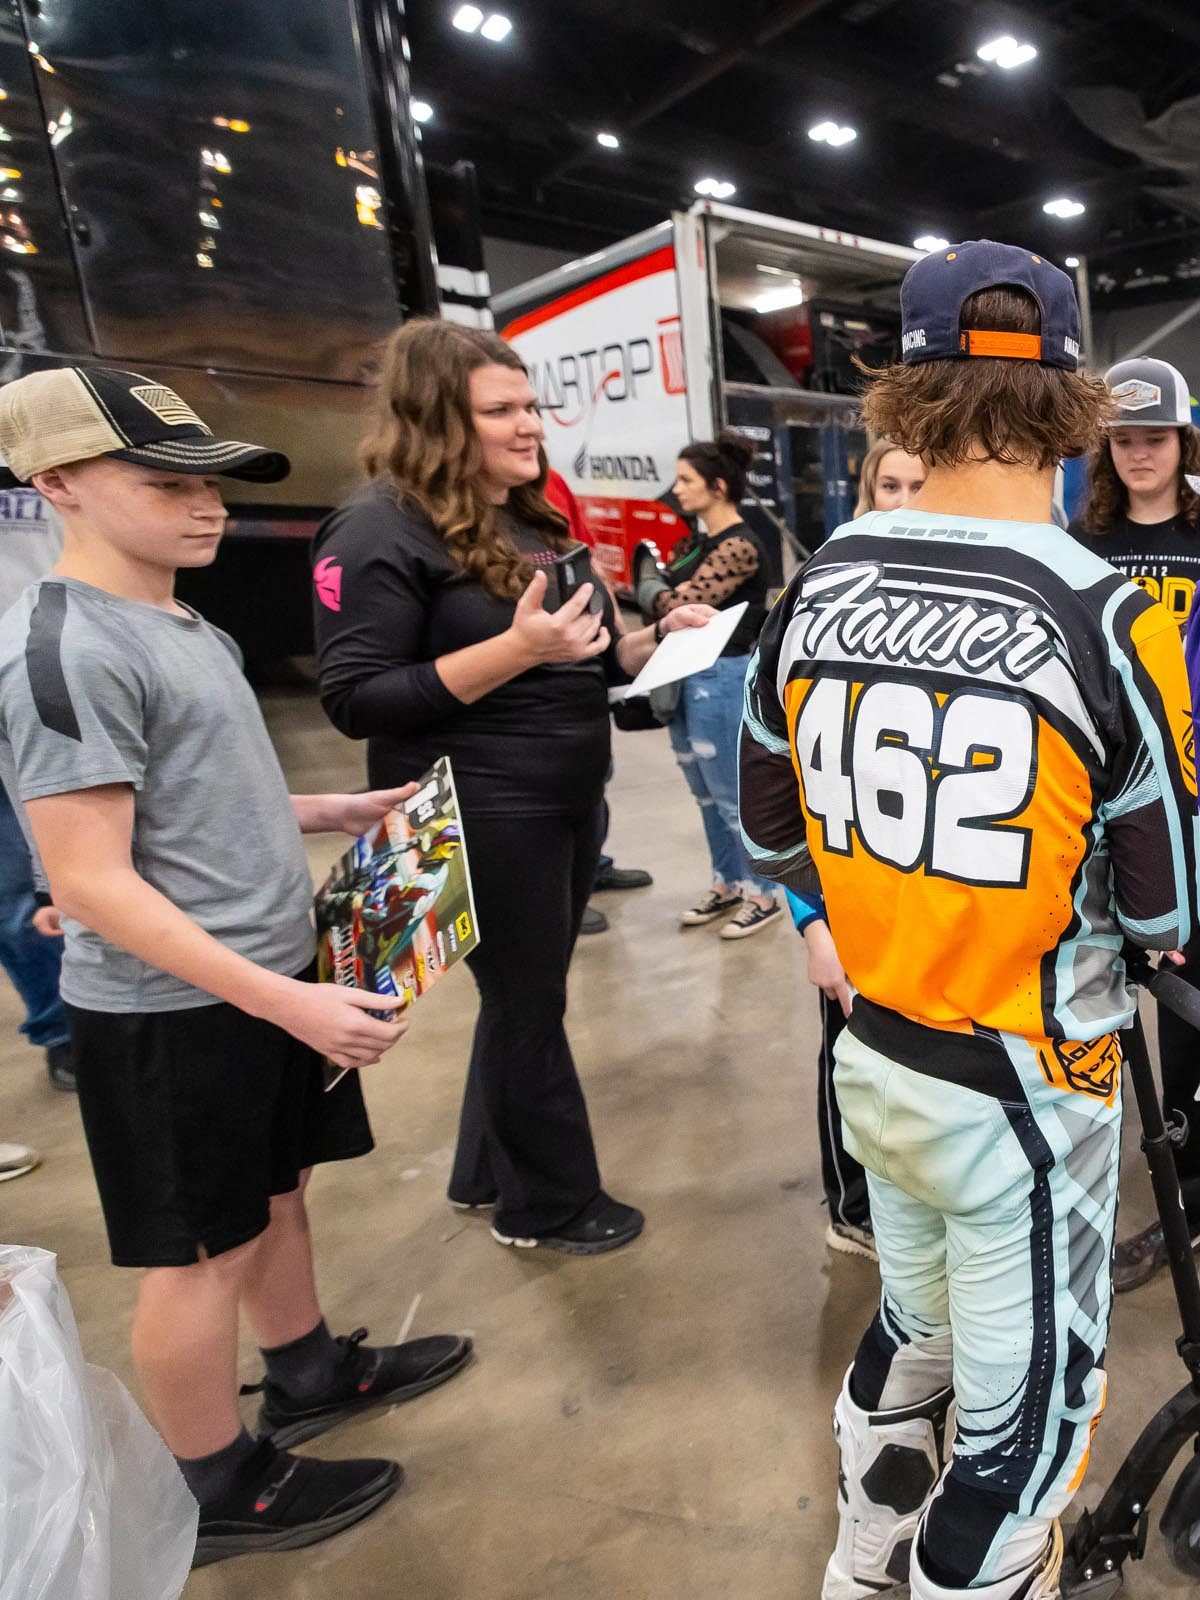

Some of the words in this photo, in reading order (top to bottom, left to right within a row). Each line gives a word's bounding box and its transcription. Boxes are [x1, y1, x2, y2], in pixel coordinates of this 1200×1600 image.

[589, 454, 661, 483] HONDA
[801, 561, 1055, 681] Fauser
[795, 677, 1035, 890] 462
